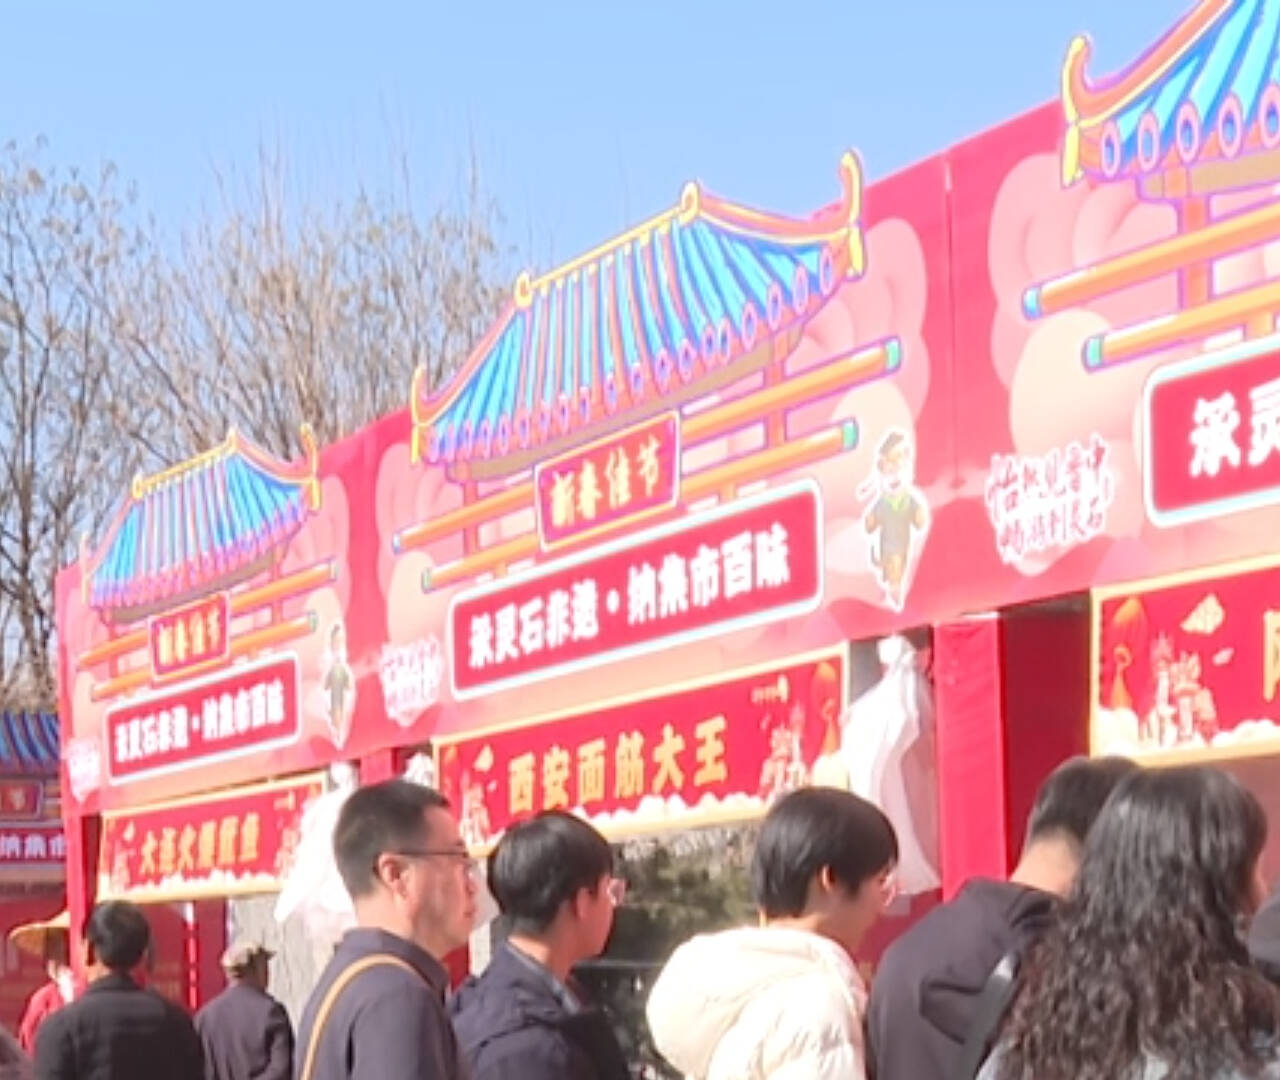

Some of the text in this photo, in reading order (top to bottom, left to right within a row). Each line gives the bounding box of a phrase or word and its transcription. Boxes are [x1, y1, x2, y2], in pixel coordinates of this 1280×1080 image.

[550, 433, 662, 528] 新春佳节
[508, 714, 728, 815] 西安面筋大王
